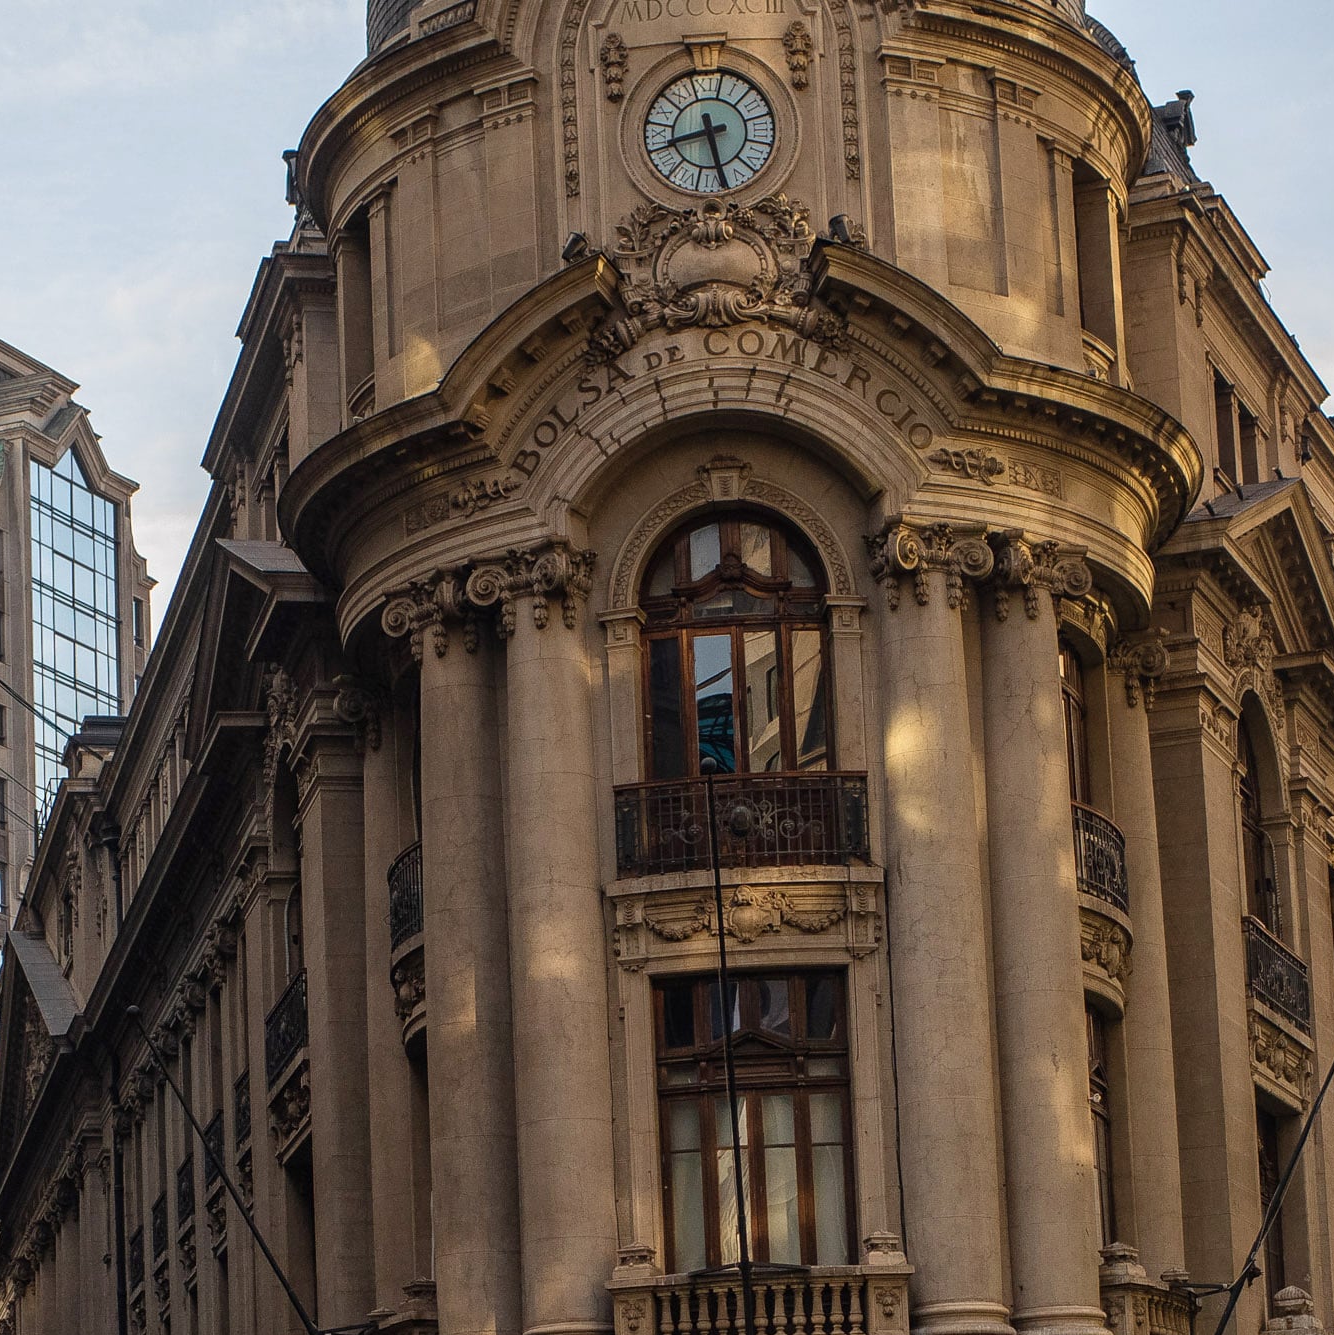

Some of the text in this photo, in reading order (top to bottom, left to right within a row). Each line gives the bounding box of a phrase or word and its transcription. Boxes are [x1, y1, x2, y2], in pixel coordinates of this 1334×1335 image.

[695, 78, 719, 92] XII
[727, 83, 737, 96] I
[671, 84, 692, 104] XI
[656, 105, 673, 120] X
[744, 99, 760, 113] II
[510, 329, 933, 480] BOLSA DE COMERCIO
